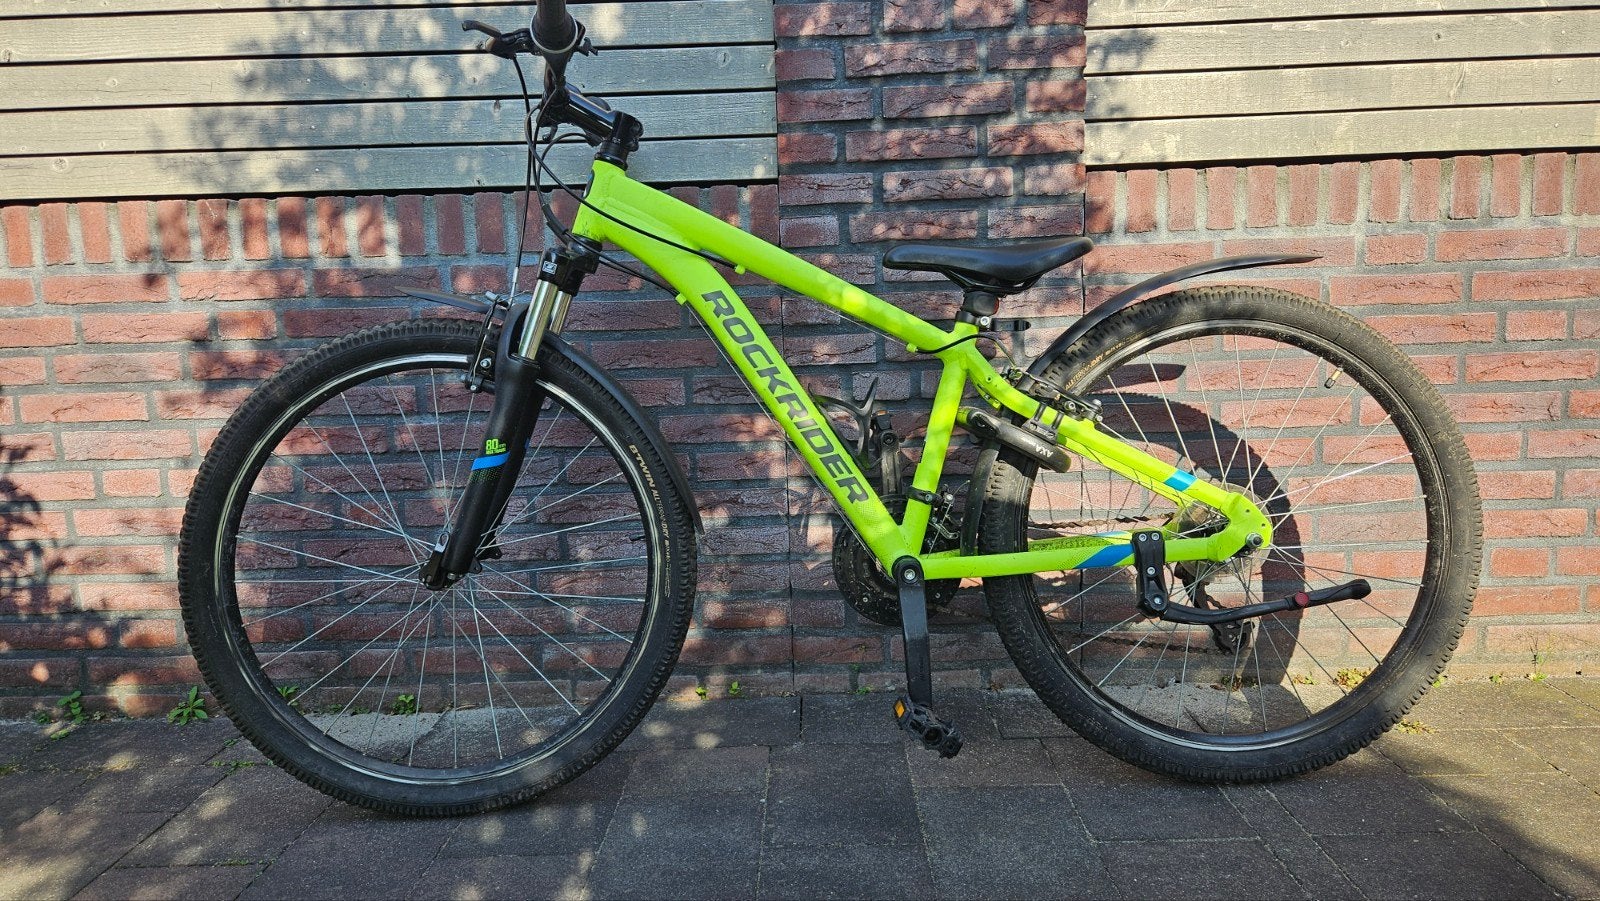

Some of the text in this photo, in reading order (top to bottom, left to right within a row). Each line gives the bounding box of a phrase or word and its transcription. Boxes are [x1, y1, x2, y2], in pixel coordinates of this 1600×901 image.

[701, 290, 869, 504] ROCKRIDER
[485, 439, 499, 450] 80
[1035, 444, 1054, 458] AXA
